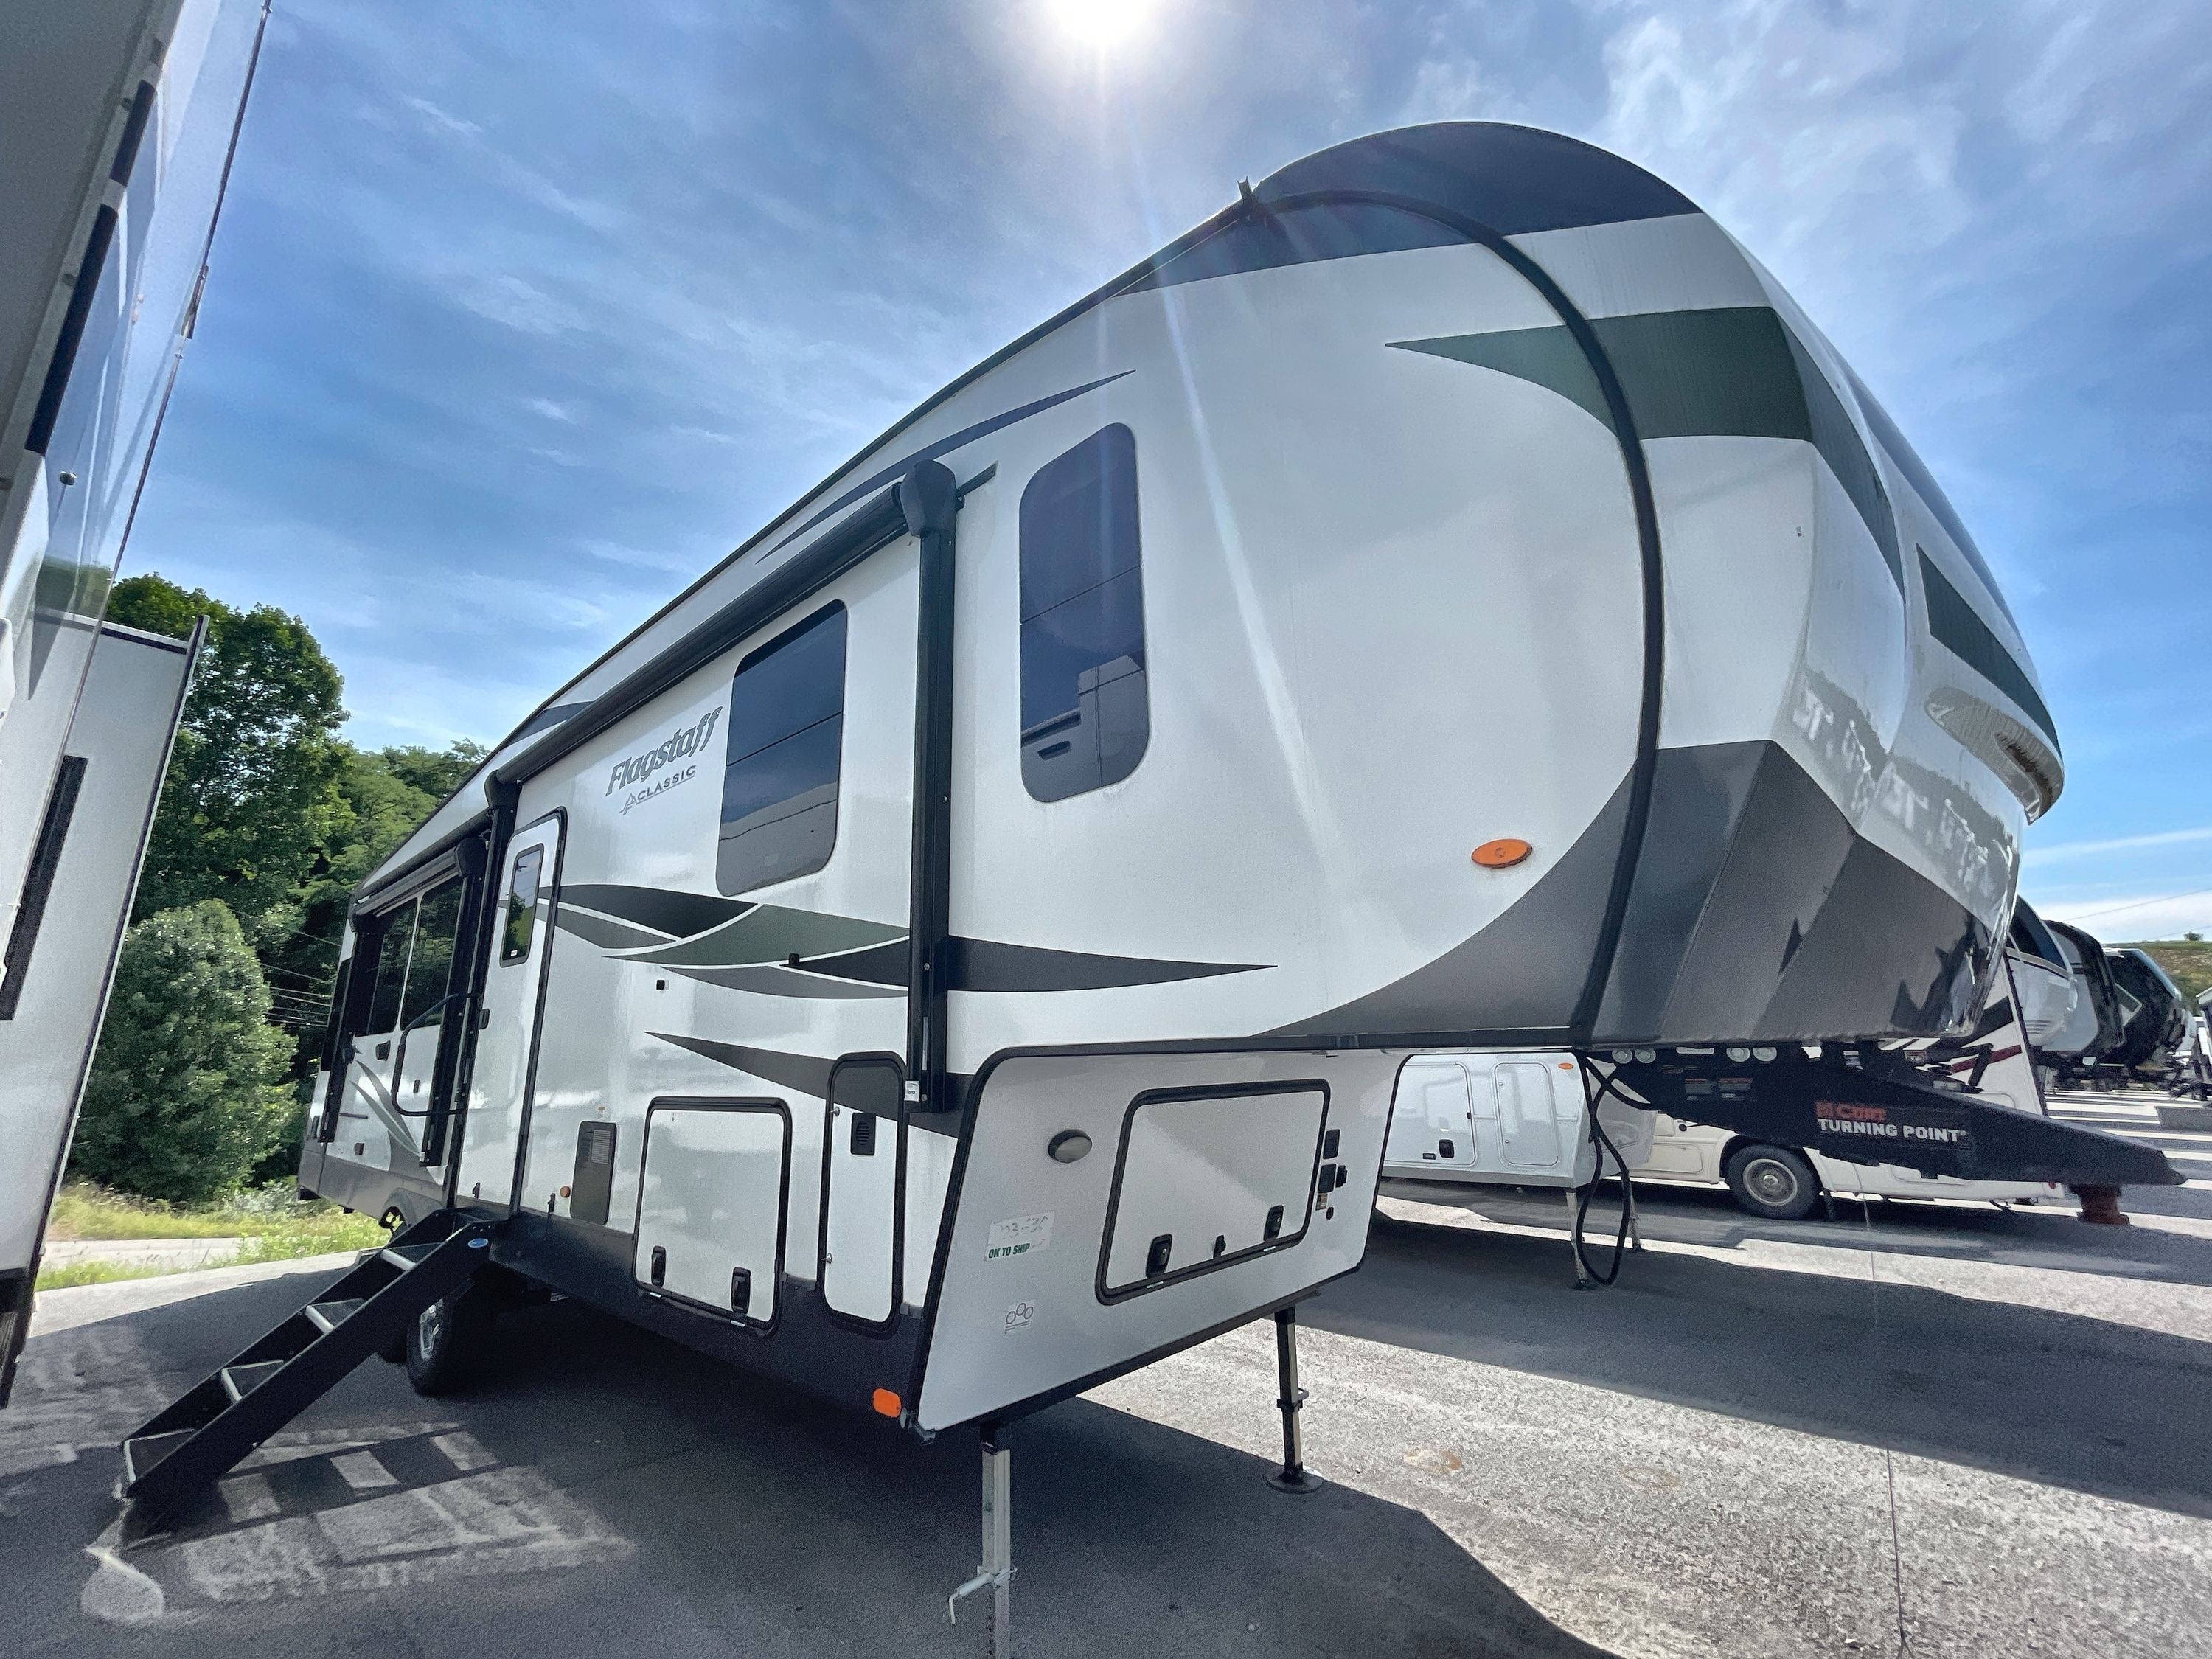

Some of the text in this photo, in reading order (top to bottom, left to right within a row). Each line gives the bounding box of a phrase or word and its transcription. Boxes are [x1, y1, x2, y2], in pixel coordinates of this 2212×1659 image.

[605, 706, 723, 796] Flagstaff
[637, 765, 697, 801] CLASSIC
[1818, 1118, 1898, 1138] TURNING
[988, 1242, 1031, 1259] OK TO SHIP
